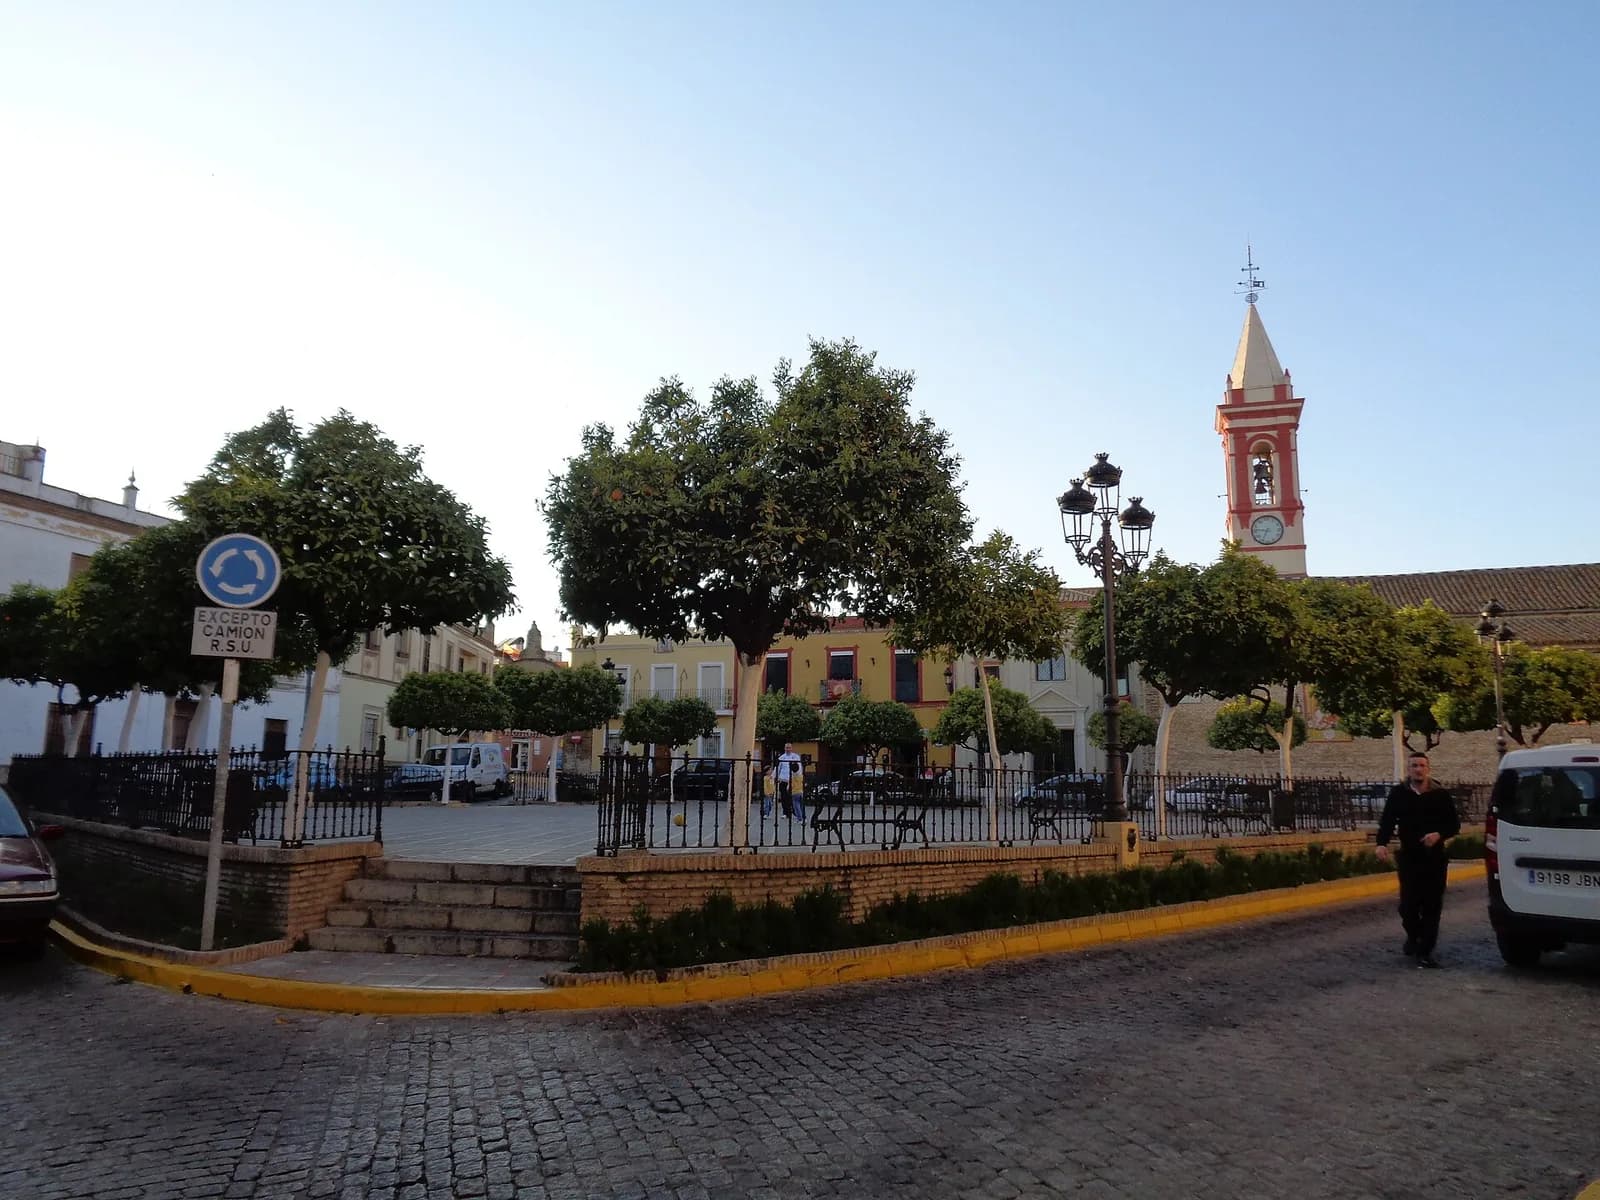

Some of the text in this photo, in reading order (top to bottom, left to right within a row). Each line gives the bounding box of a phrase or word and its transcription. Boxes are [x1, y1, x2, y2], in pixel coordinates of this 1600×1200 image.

[198, 610, 271, 626] EXCEPTO
[202, 625, 265, 640] CAMION
[210, 639, 254, 653] R.S.U.
[1536, 871, 1570, 885] 9198
